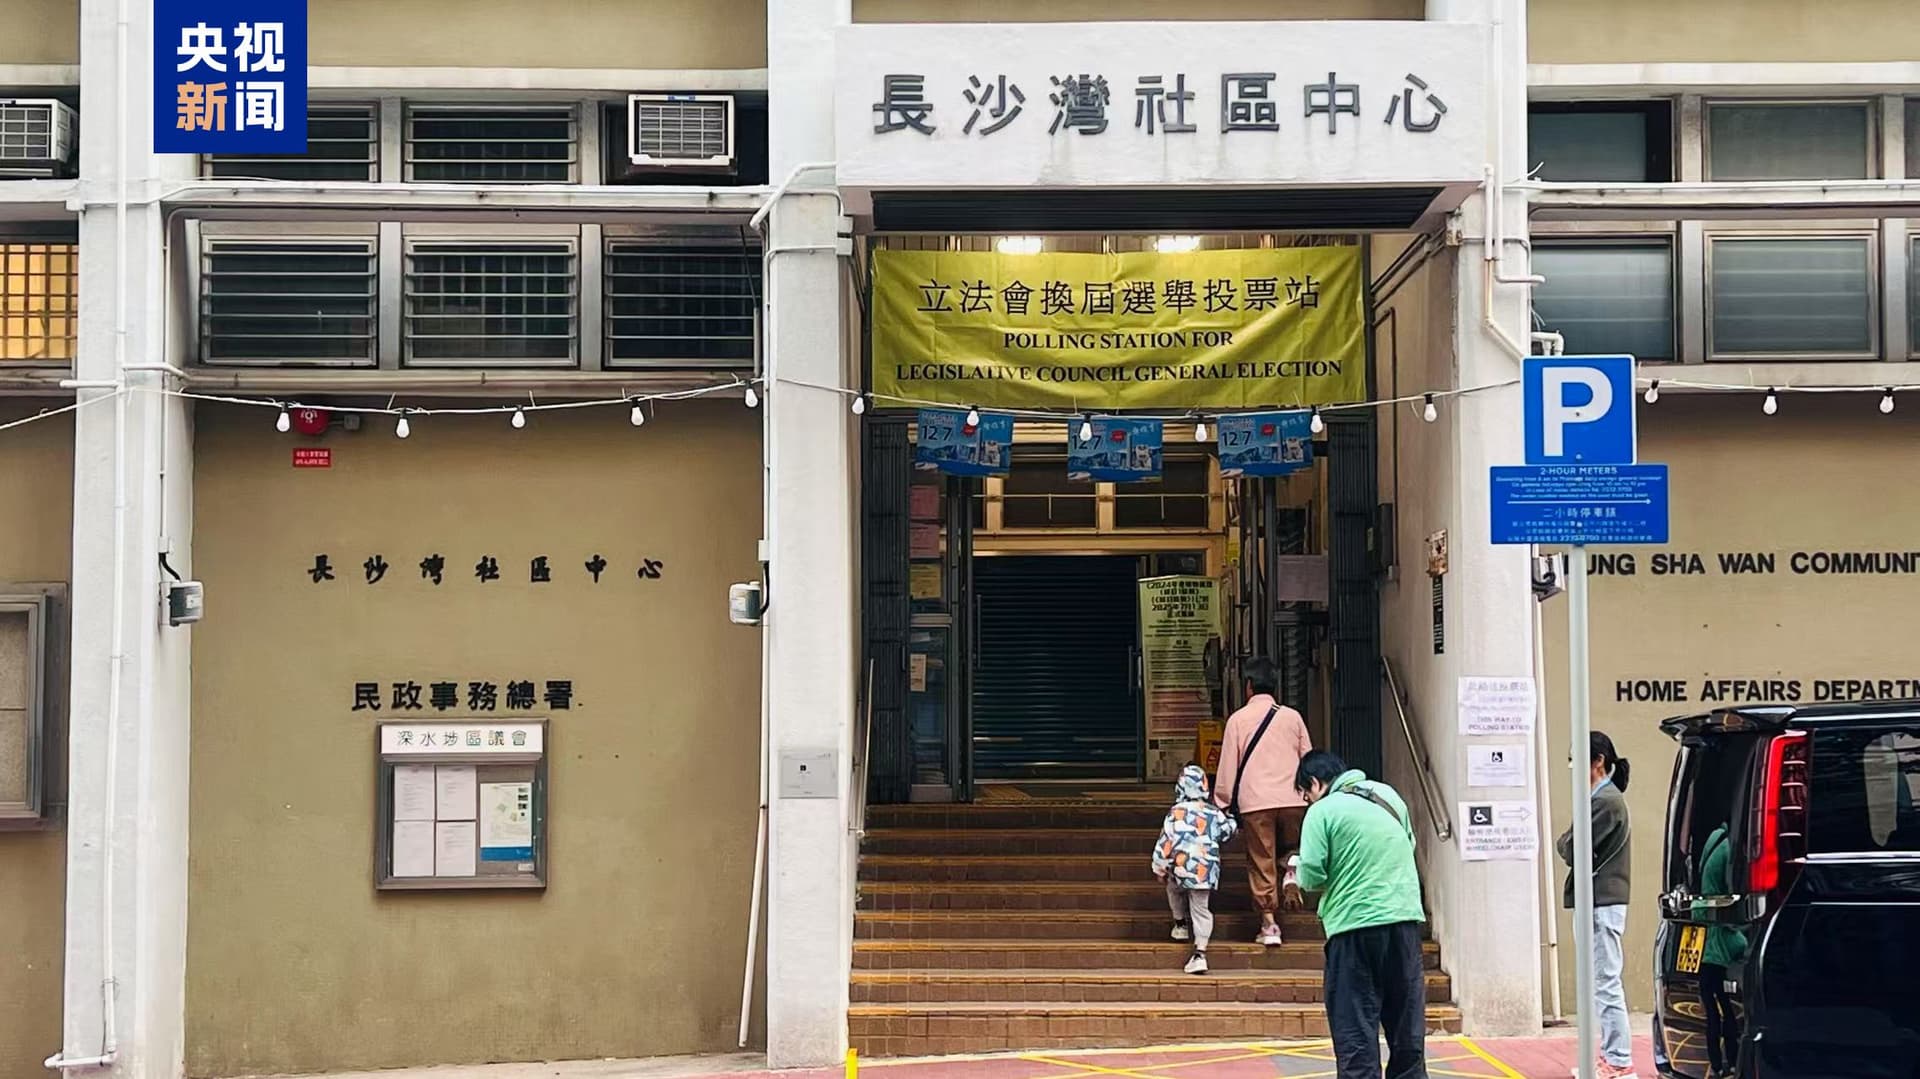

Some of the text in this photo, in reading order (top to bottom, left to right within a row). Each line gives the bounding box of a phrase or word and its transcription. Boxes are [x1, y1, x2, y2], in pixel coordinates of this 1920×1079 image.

[872, 71, 1447, 136] 長沙灣社區中心
[917, 275, 1321, 316] 立法會換屆選舉投票站
[1004, 330, 1233, 350] POLLING STATION FOR
[896, 359, 1343, 382] LEGISLATIVE COUNCIL GENERAL ELECTION
[1542, 366, 1613, 457] P
[1540, 466, 1618, 475] 2-HOUR METERS
[307, 554, 663, 585] 長沙灣社區中心
[1651, 552, 1706, 575] SHA
[1718, 552, 1775, 574] WAN
[351, 680, 573, 711] 民政事務總署
[1616, 680, 1688, 705] HOME
[1700, 679, 1801, 703] AFFAIRS
[397, 730, 528, 747] 深水埗區議會
